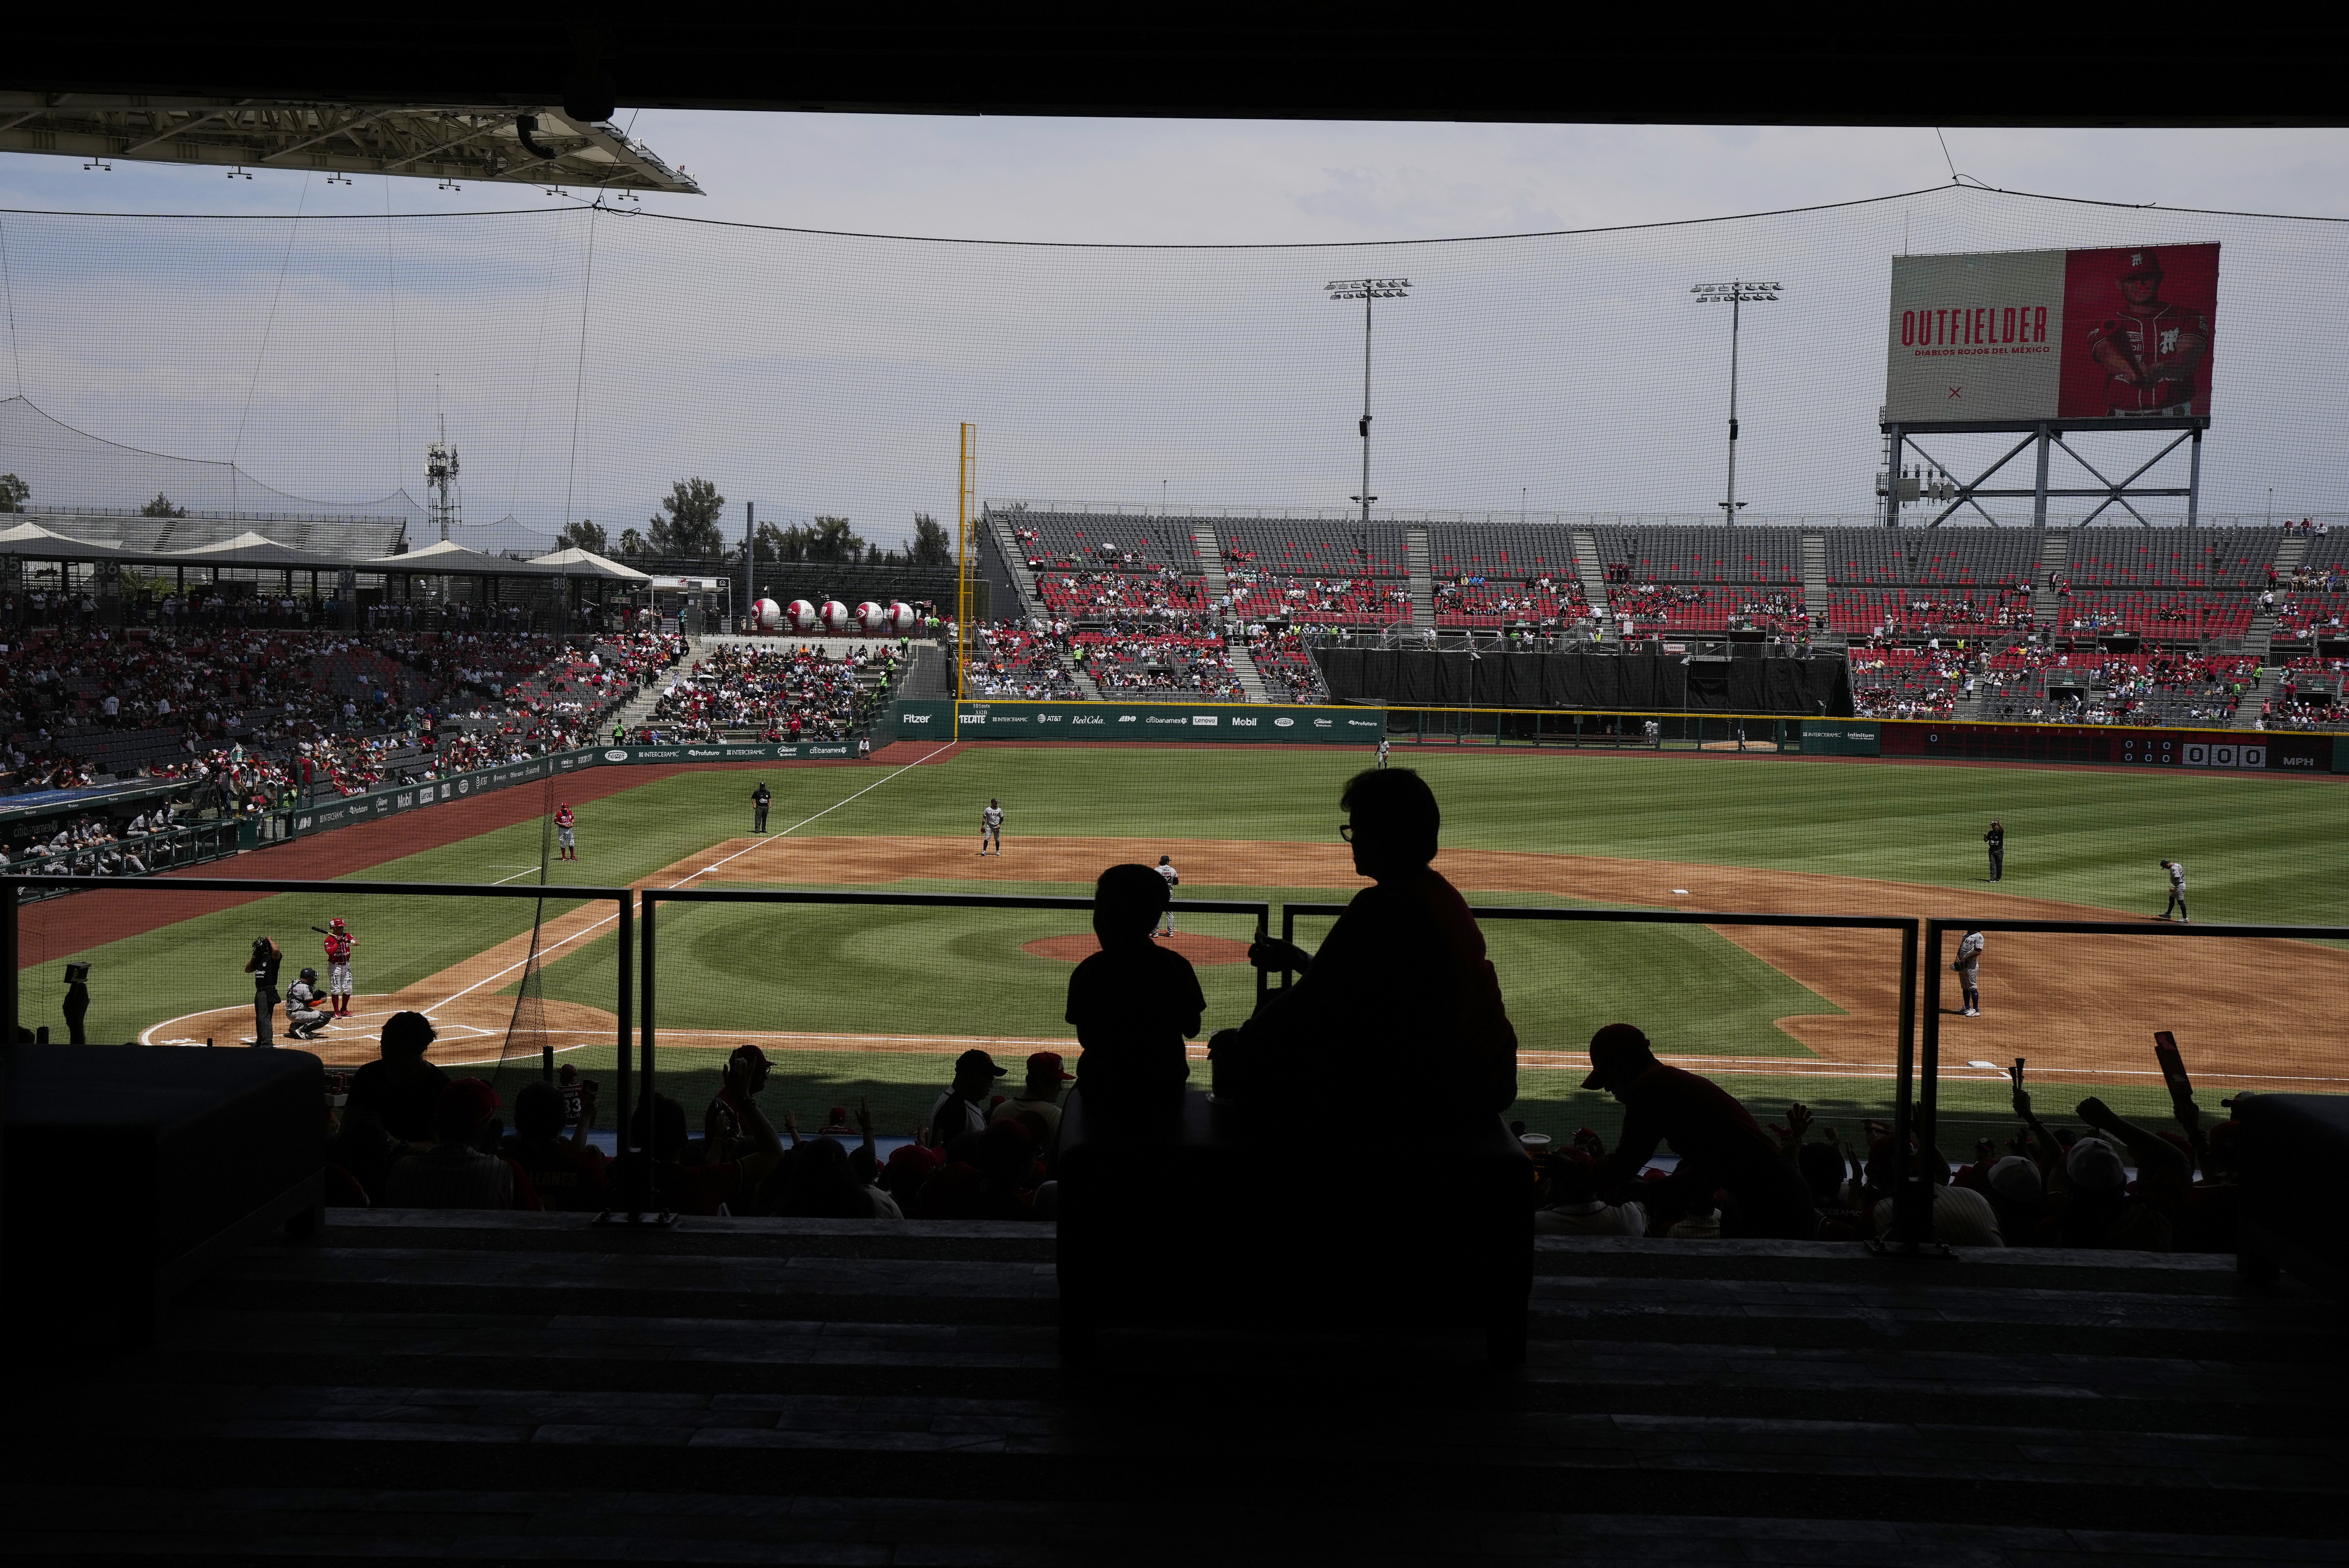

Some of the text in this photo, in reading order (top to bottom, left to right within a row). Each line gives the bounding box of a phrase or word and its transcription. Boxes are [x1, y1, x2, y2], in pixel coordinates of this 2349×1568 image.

[1902, 306, 2047, 346] OUTFIELDER
[95, 561, 118, 575] B6
[338, 570, 354, 583] B7
[553, 578, 566, 590] B8
[903, 714, 930, 723] Fitzer
[958, 715, 987, 724] TECATE
[1232, 717, 1257, 726] Mobil
[2125, 740, 2133, 749] 0
[2124, 753, 2133, 761] 0
[2162, 754, 2170, 763] 0
[2189, 747, 2260, 764] 0 0 0
[2283, 757, 2314, 766] MPH
[397, 792, 412, 809] Mobil
[354, 805, 368, 814] Profuturo
[323, 810, 344, 822] INTERCERAMIC
[14, 823, 52, 838] citibanamex
[1821, 1208, 1862, 1217] CERAMIC
